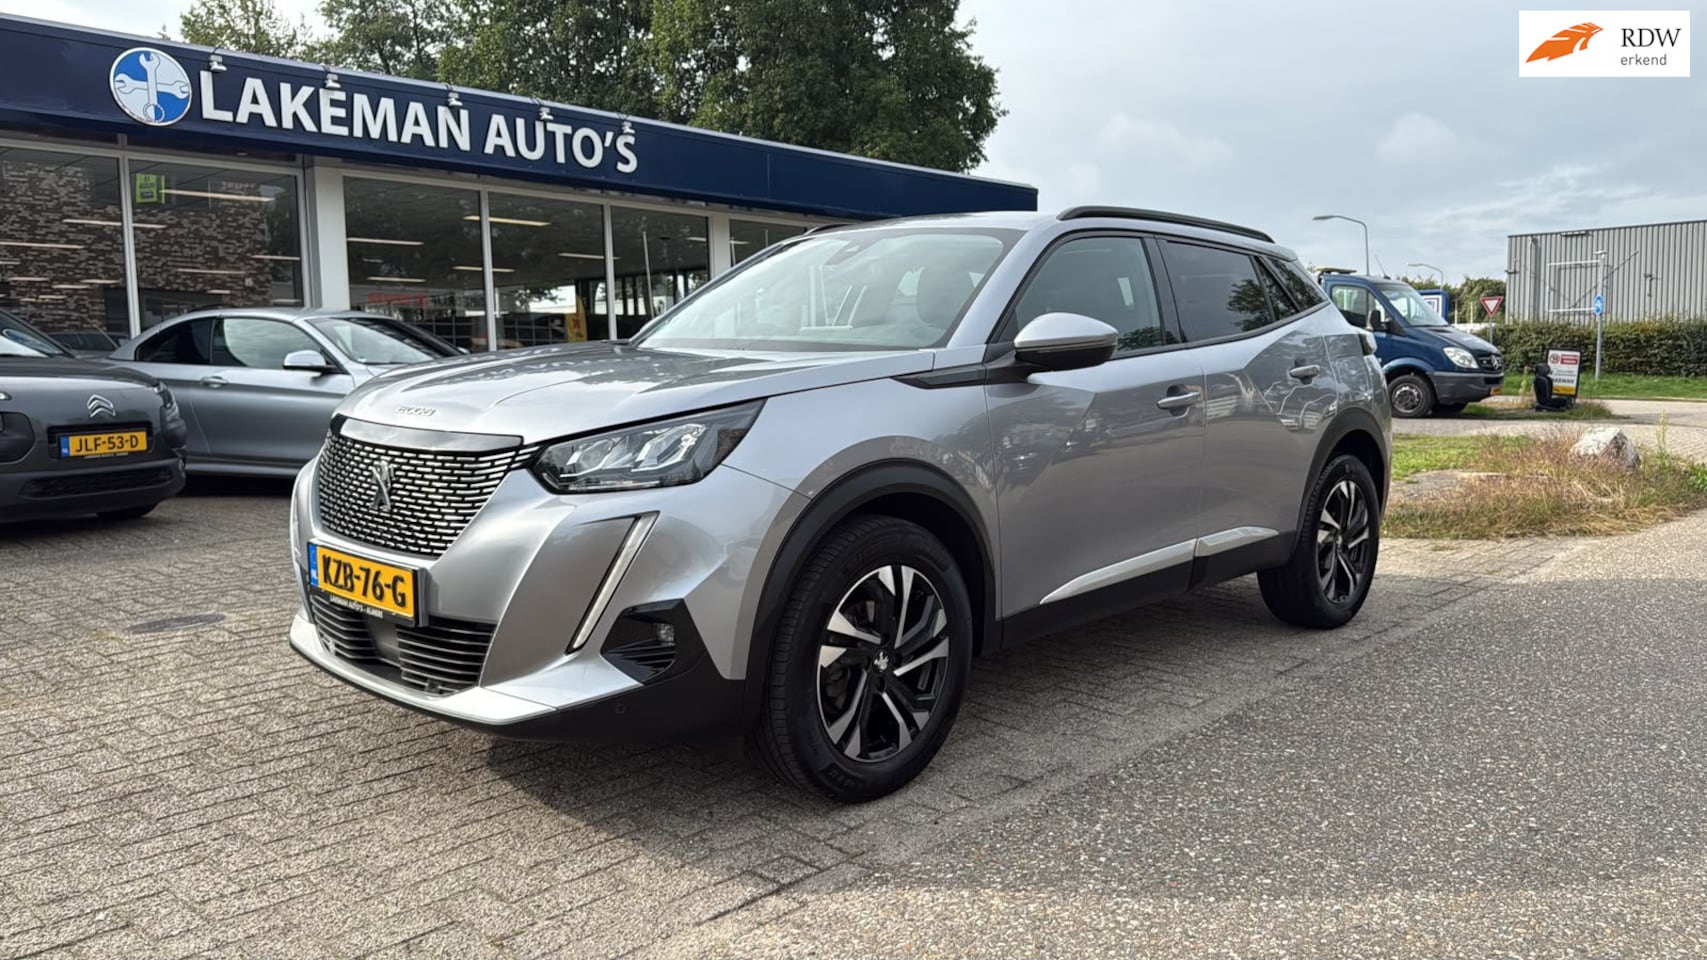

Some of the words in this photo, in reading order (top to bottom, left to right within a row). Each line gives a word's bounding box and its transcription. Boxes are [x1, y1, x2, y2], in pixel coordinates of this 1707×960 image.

[200, 70, 471, 151] LAKEMAN
[483, 114, 638, 173] AUTO'S
[75, 434, 139, 453] JLF-53-D
[322, 554, 406, 608] KZB-76-G
